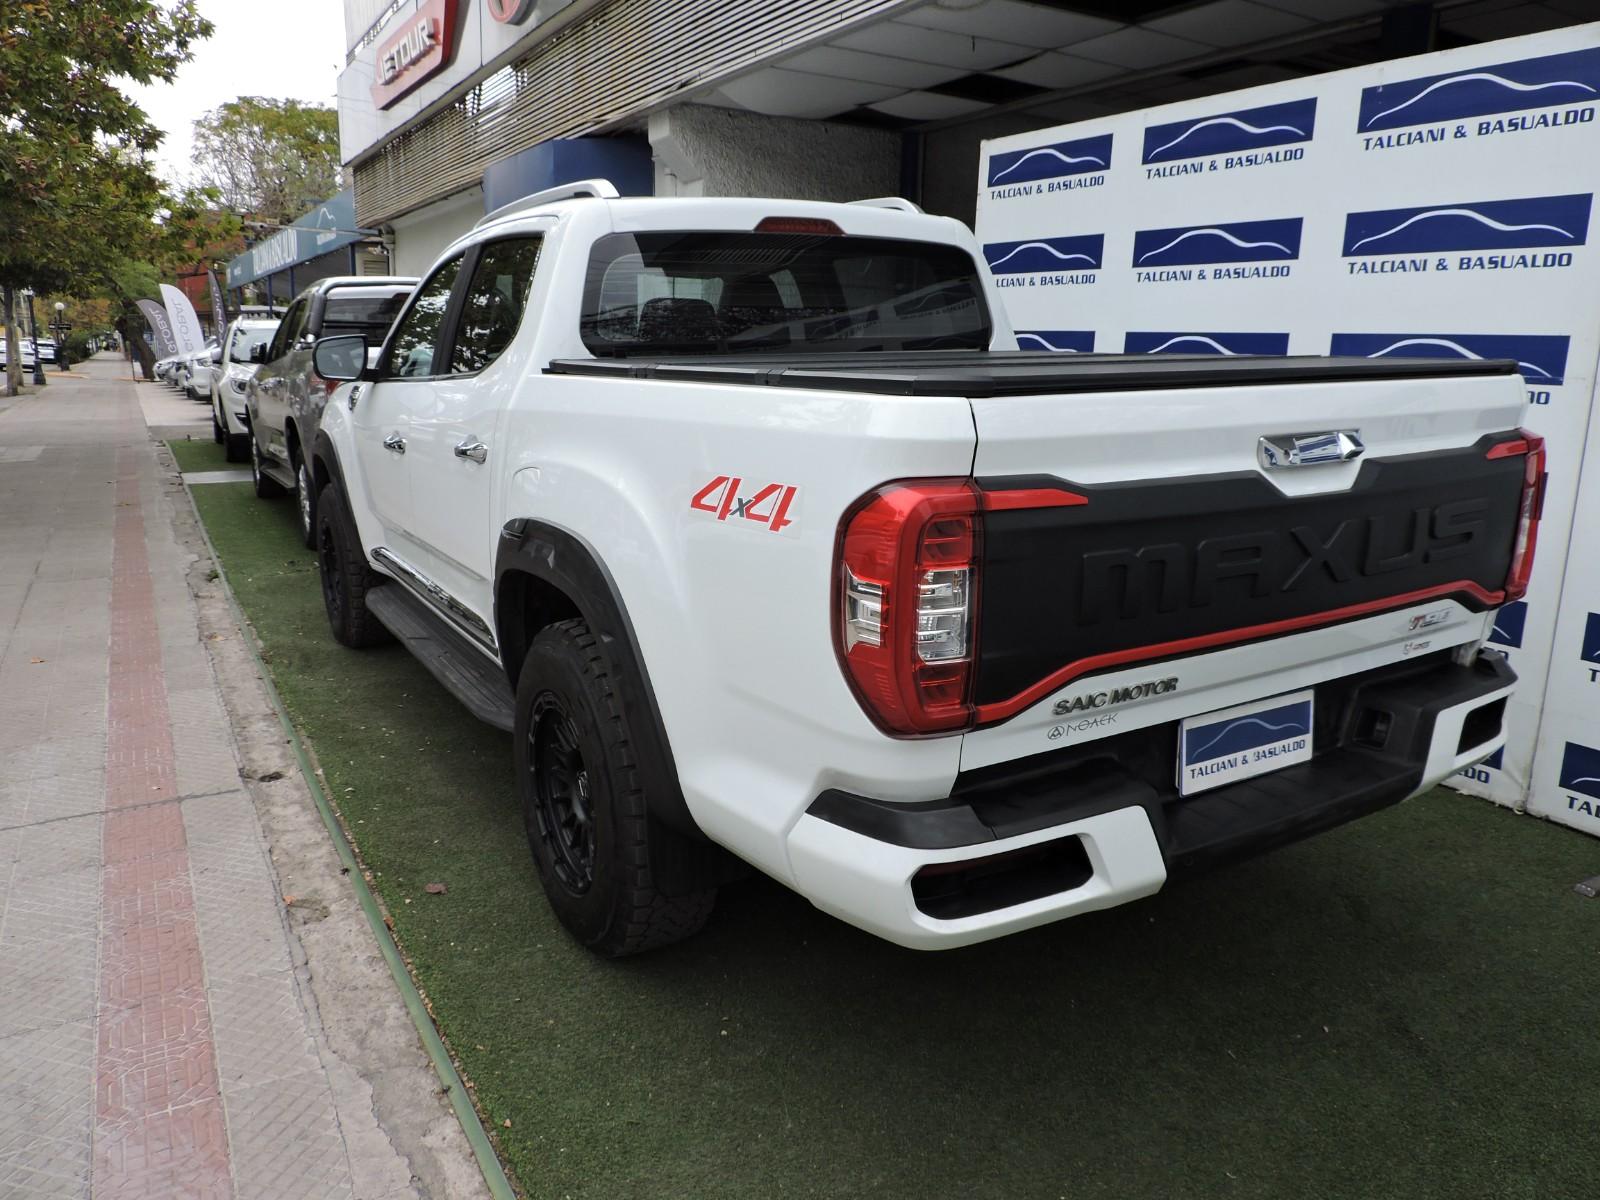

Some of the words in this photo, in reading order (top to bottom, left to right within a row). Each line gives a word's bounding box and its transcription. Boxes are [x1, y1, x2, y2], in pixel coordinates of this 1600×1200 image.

[1363, 127, 1446, 151] TALCIANI
[1453, 125, 1467, 139] &
[1477, 107, 1596, 136] BASUALDO
[1146, 162, 1204, 180] TALCIANI
[1208, 160, 1218, 172] &
[1225, 147, 1304, 170] BASUALDO
[991, 186, 1033, 200] TALCIANI
[1036, 184, 1043, 194] &
[1047, 175, 1105, 193] BASUALDO
[1136, 270, 1192, 283] TALCIANI
[1197, 269, 1207, 281] &
[1213, 265, 1291, 280] BASUALDO
[1348, 259, 1428, 275] TALCIANI
[1436, 258, 1448, 271] &
[1458, 252, 1573, 271] BASUALDO
[1029, 276, 1036, 287] &
[1040, 274, 1096, 287] BASUALDO
[690, 475, 798, 532] 4x4
[1077, 501, 1489, 627] MAXUS
[1052, 691, 1108, 716] SAIC
[1108, 676, 1180, 706] MOTOR
[1189, 757, 1238, 779] TALCIANI
[1241, 755, 1249, 766] &
